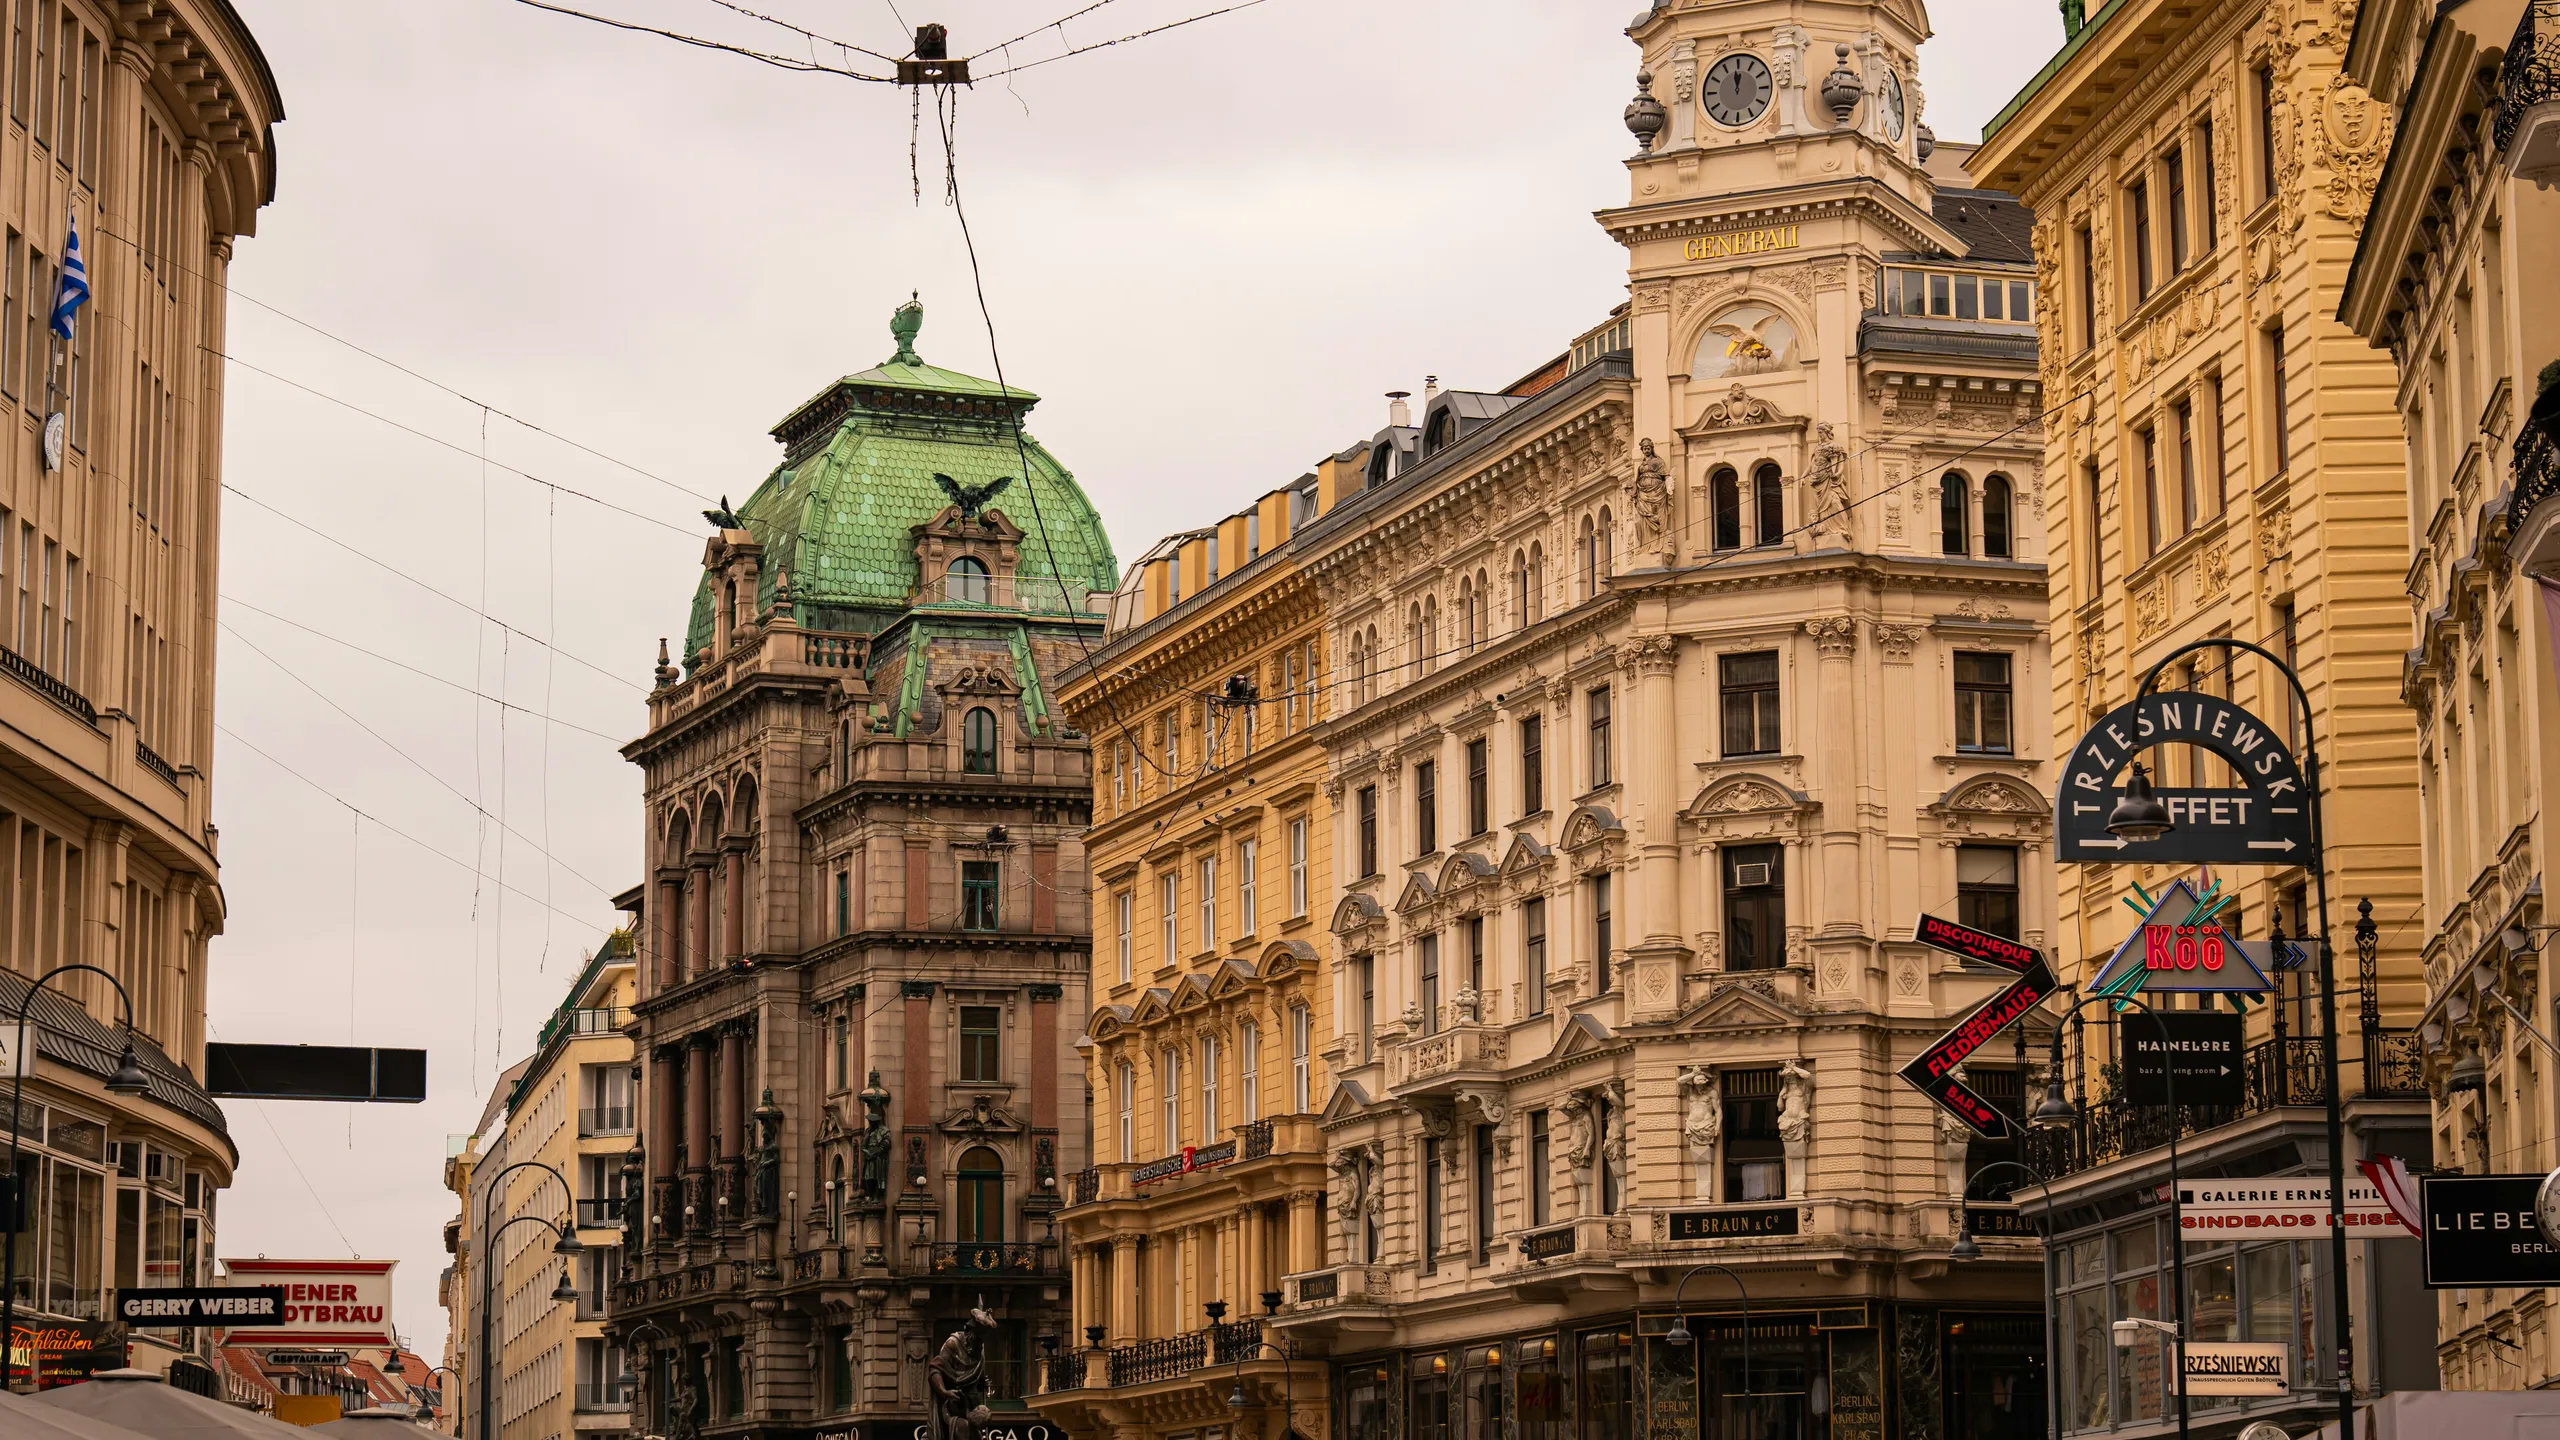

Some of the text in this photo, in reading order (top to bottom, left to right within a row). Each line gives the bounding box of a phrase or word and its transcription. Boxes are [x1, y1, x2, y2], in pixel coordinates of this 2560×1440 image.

[1683, 225, 1800, 261] GENERALI
[1927, 919, 2033, 963] DISCOTHEQUE
[2144, 924, 2225, 971] Köö
[1957, 1004, 1995, 1038] CABARET
[1927, 986, 2038, 1078] FLEDERMAUS
[2140, 1066, 2153, 1074] bar
[1945, 1084, 1976, 1111] BAR
[1192, 1153, 1208, 1166] VIENNA
[1208, 1147, 1232, 1161] INSURANCE
[2201, 1190, 2278, 1202] GALERIE
[2285, 1189, 2332, 1201] ERNS
[1684, 1219, 1696, 1233] E.
[1702, 1217, 1749, 1233] BRAUN
[1755, 1221, 1761, 1231] &
[1978, 1215, 2033, 1231] E. BRAU
[2180, 1213, 2404, 1229] SINDBADS EISE
[2435, 1212, 2535, 1230] LIEBE
[1539, 1236, 1559, 1253] BRAUN
[2511, 1243, 2557, 1253] BERL
[124, 1297, 274, 1317] GERRY WEBER
[284, 1304, 383, 1323] DTBRÄU
[10, 1325, 93, 1350] Tuchlauben
[273, 1355, 342, 1364] RESTAURANT
[41, 1367, 83, 1376] sandwiches
[1657, 1401, 1689, 1413] BERLIN
[1841, 1395, 1873, 1407] BERLIN
[1650, 1417, 1697, 1429] KARLSBAD
[1832, 1412, 1881, 1424] KARLSBAD
